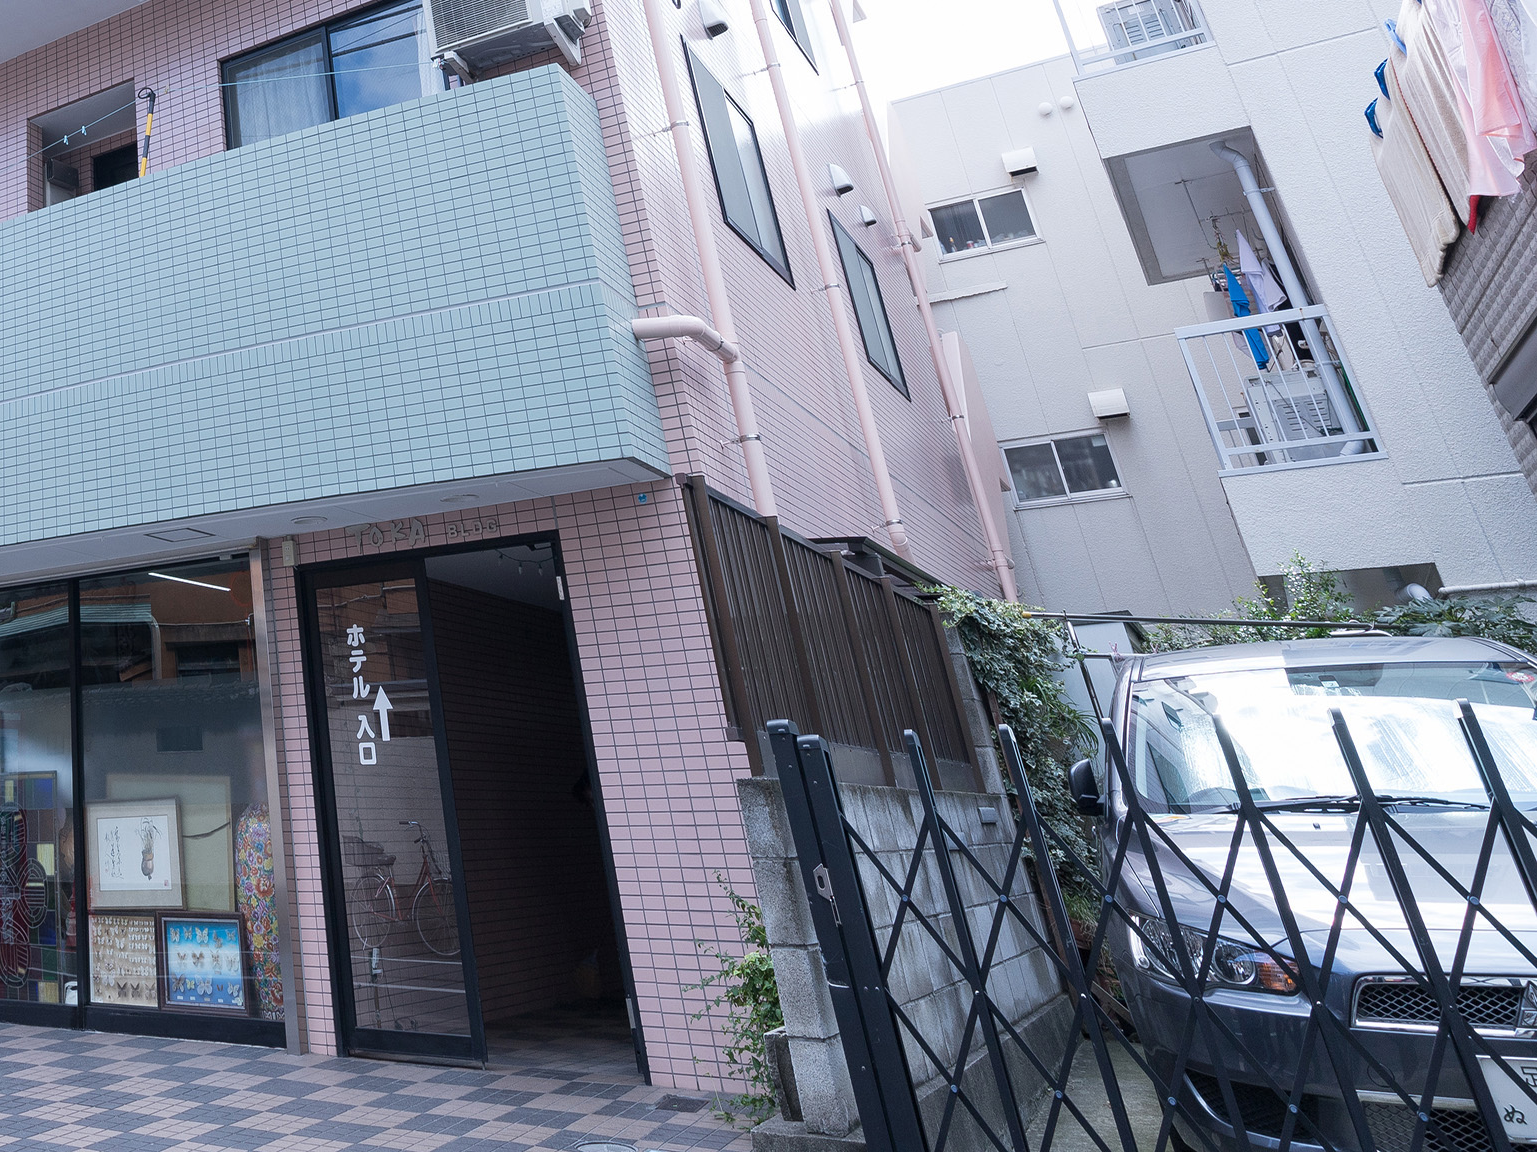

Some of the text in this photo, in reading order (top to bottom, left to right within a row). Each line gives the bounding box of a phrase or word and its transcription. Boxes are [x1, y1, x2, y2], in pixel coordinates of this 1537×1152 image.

[345, 518, 498, 554] TOKA BLDG
[1504, 1104, 1528, 1125] ぬ
